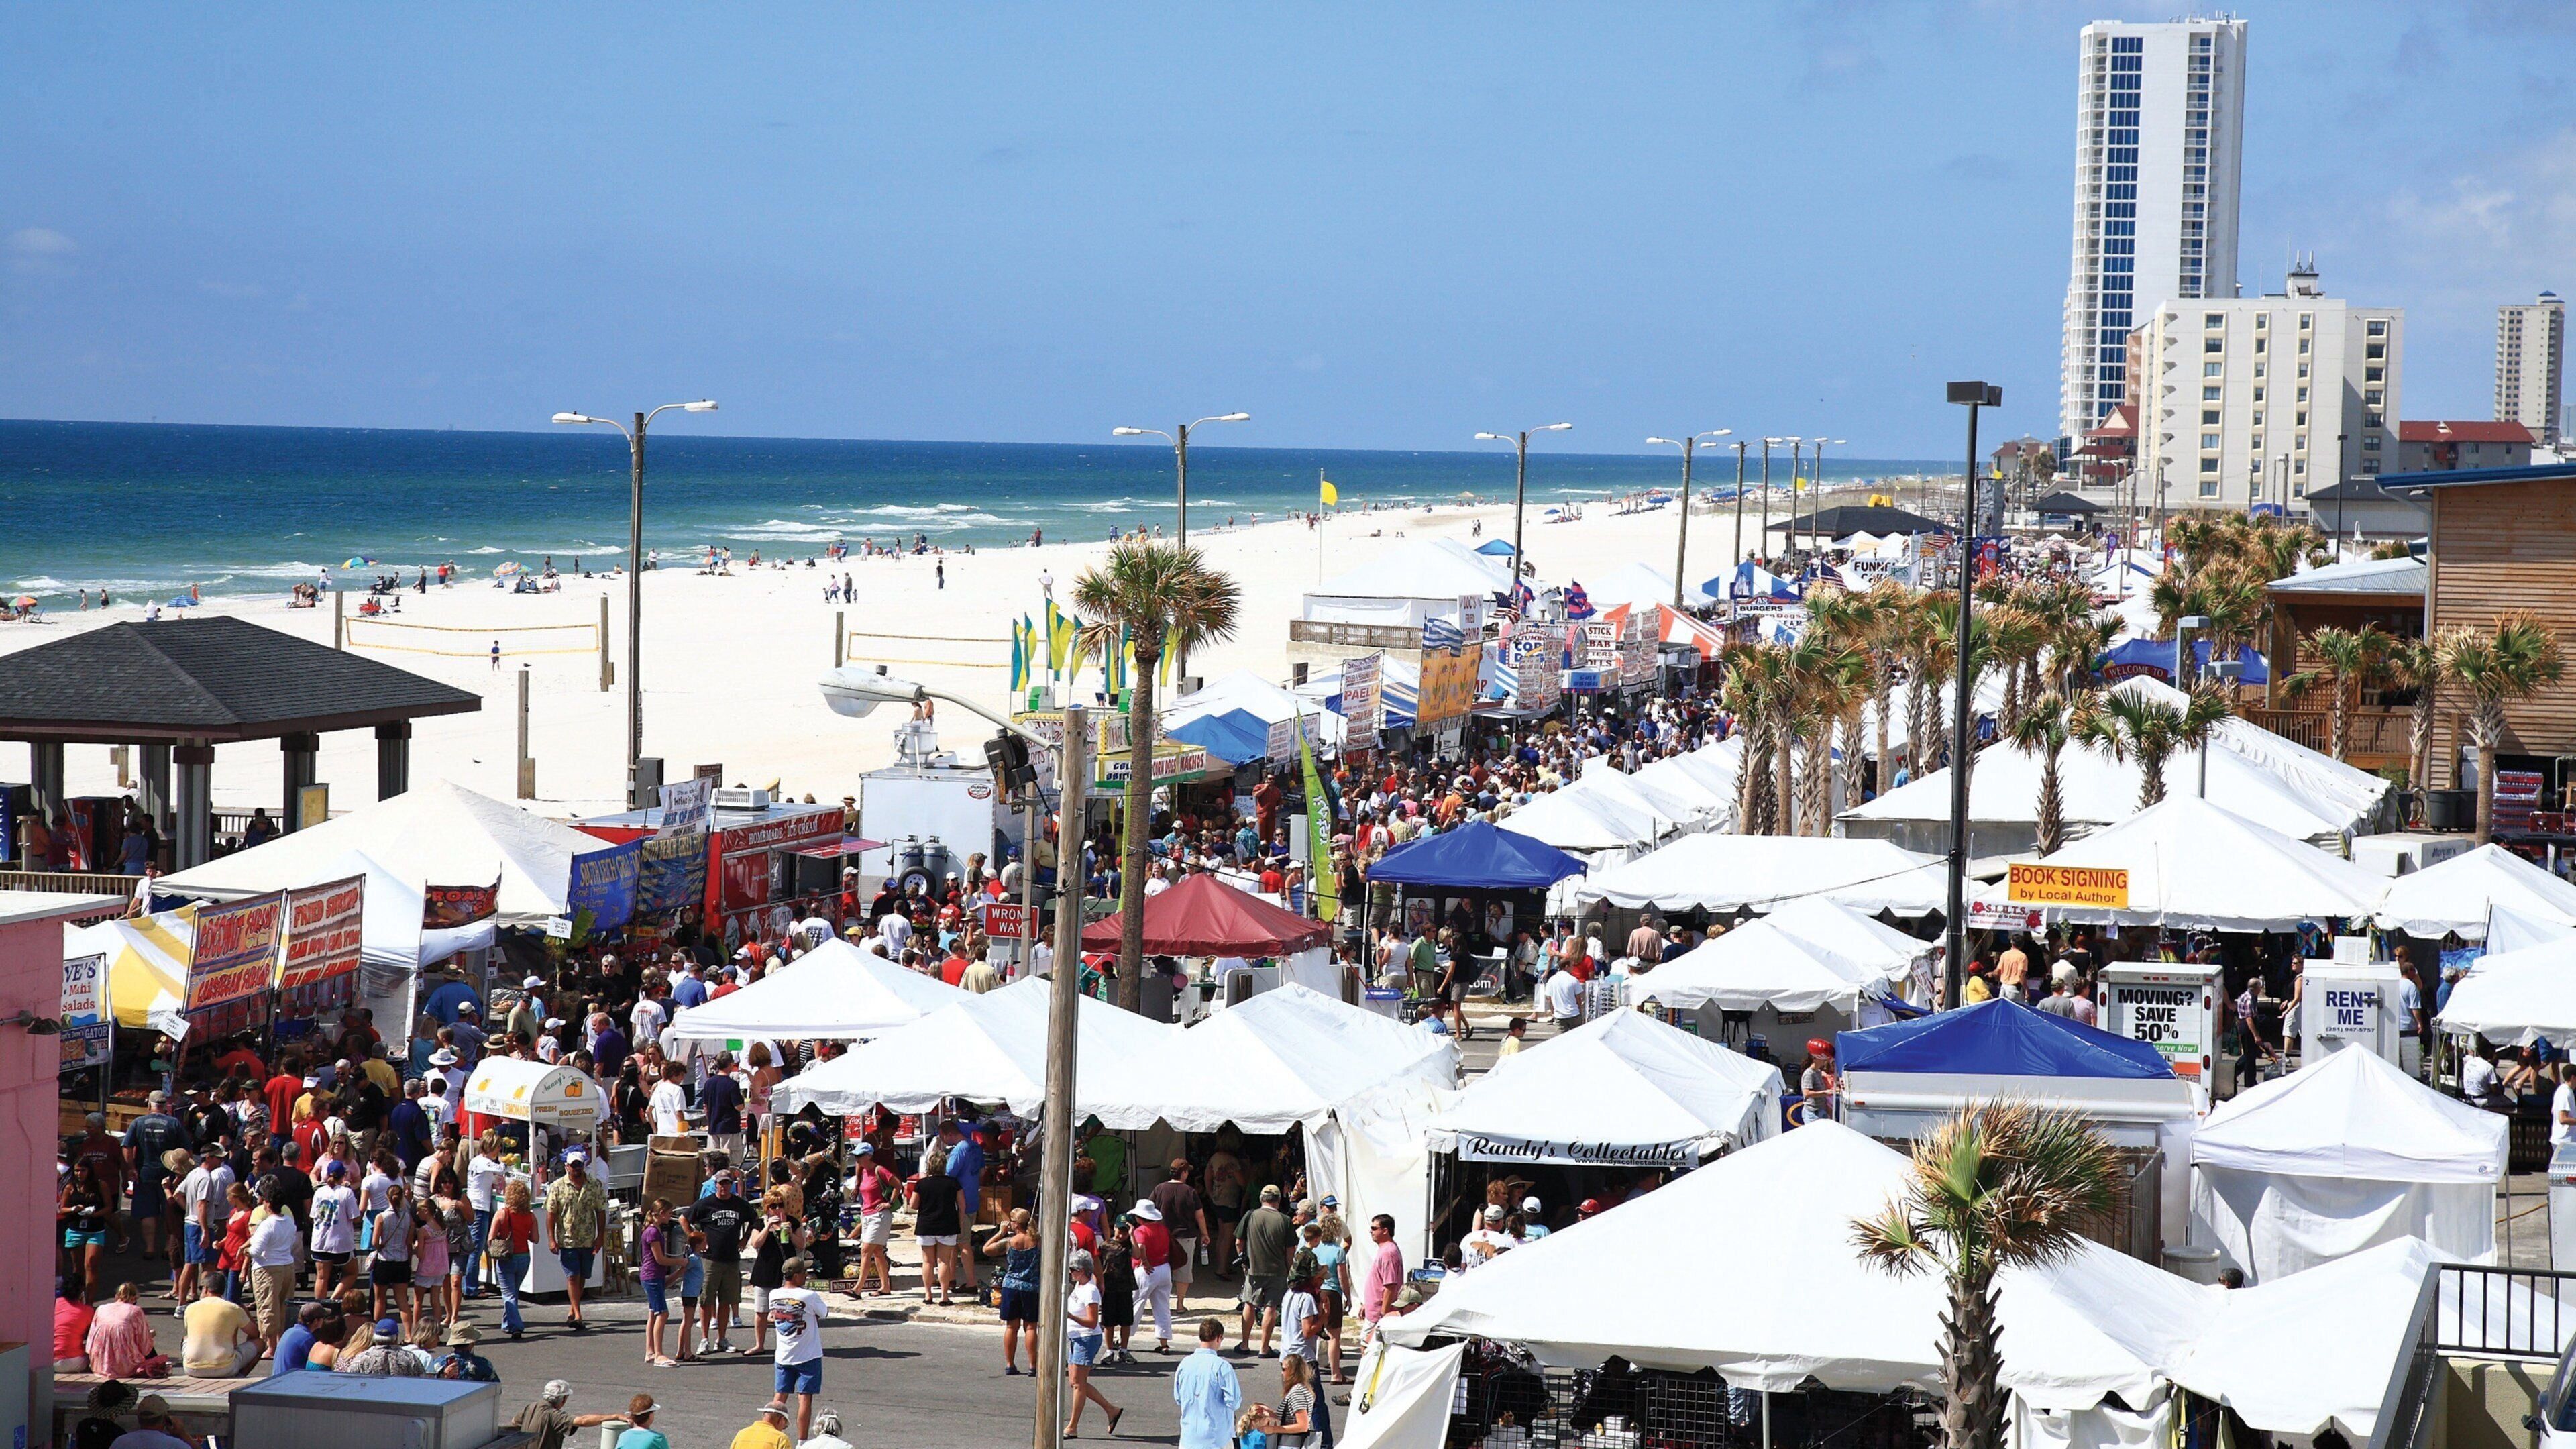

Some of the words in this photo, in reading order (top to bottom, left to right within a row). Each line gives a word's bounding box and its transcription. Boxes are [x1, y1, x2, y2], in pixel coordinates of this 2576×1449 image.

[1588, 627, 1611, 635] STICK
[1514, 641, 1543, 651] COR
[2109, 665, 2149, 676] WELCOME
[2153, 668, 2163, 677] TO
[1344, 684, 1379, 701] PAELLA
[1152, 761, 1165, 778] CORN
[1165, 758, 1177, 775] DOGS
[1179, 753, 1204, 772] NACHOS
[749, 827, 784, 845] HOMEMADE
[788, 826, 798, 837] ICE
[798, 821, 818, 835] CREAM
[2010, 867, 2057, 885] BOOK
[2061, 869, 2127, 890] SIGNING
[2020, 889, 2035, 900] by
[2039, 889, 2072, 900] Local
[2076, 891, 2116, 903] Author
[294, 899, 324, 928] FRIED
[326, 887, 358, 919] SHRIMP
[991, 908, 1024, 920] WRON
[999, 922, 1023, 934] WAY
[198, 913, 246, 958] COCONUT
[69, 982, 92, 996] Mahi
[2118, 989, 2194, 1006] MOVING?
[2326, 991, 2376, 1008] RENT
[61, 998, 95, 1012] Salads
[2135, 1006, 2176, 1022] SAVE
[2337, 1008, 2364, 1025] ME
[85, 1026, 108, 1039] GATOR
[2134, 1023, 2179, 1042] 50%
[91, 1040, 108, 1051] BITES
[2178, 1044, 2198, 1053] Now!
[541, 1073, 566, 1095] Nanny's
[535, 1105, 557, 1114] FRESH
[558, 1107, 594, 1117] SQUEEZED
[1466, 1136, 1558, 1161] Randy's
[1567, 1140, 1690, 1161] Collectables
[1574, 1157, 1686, 1167] www.randyscollectables.com
[712, 1210, 739, 1221] SOUTHERN
